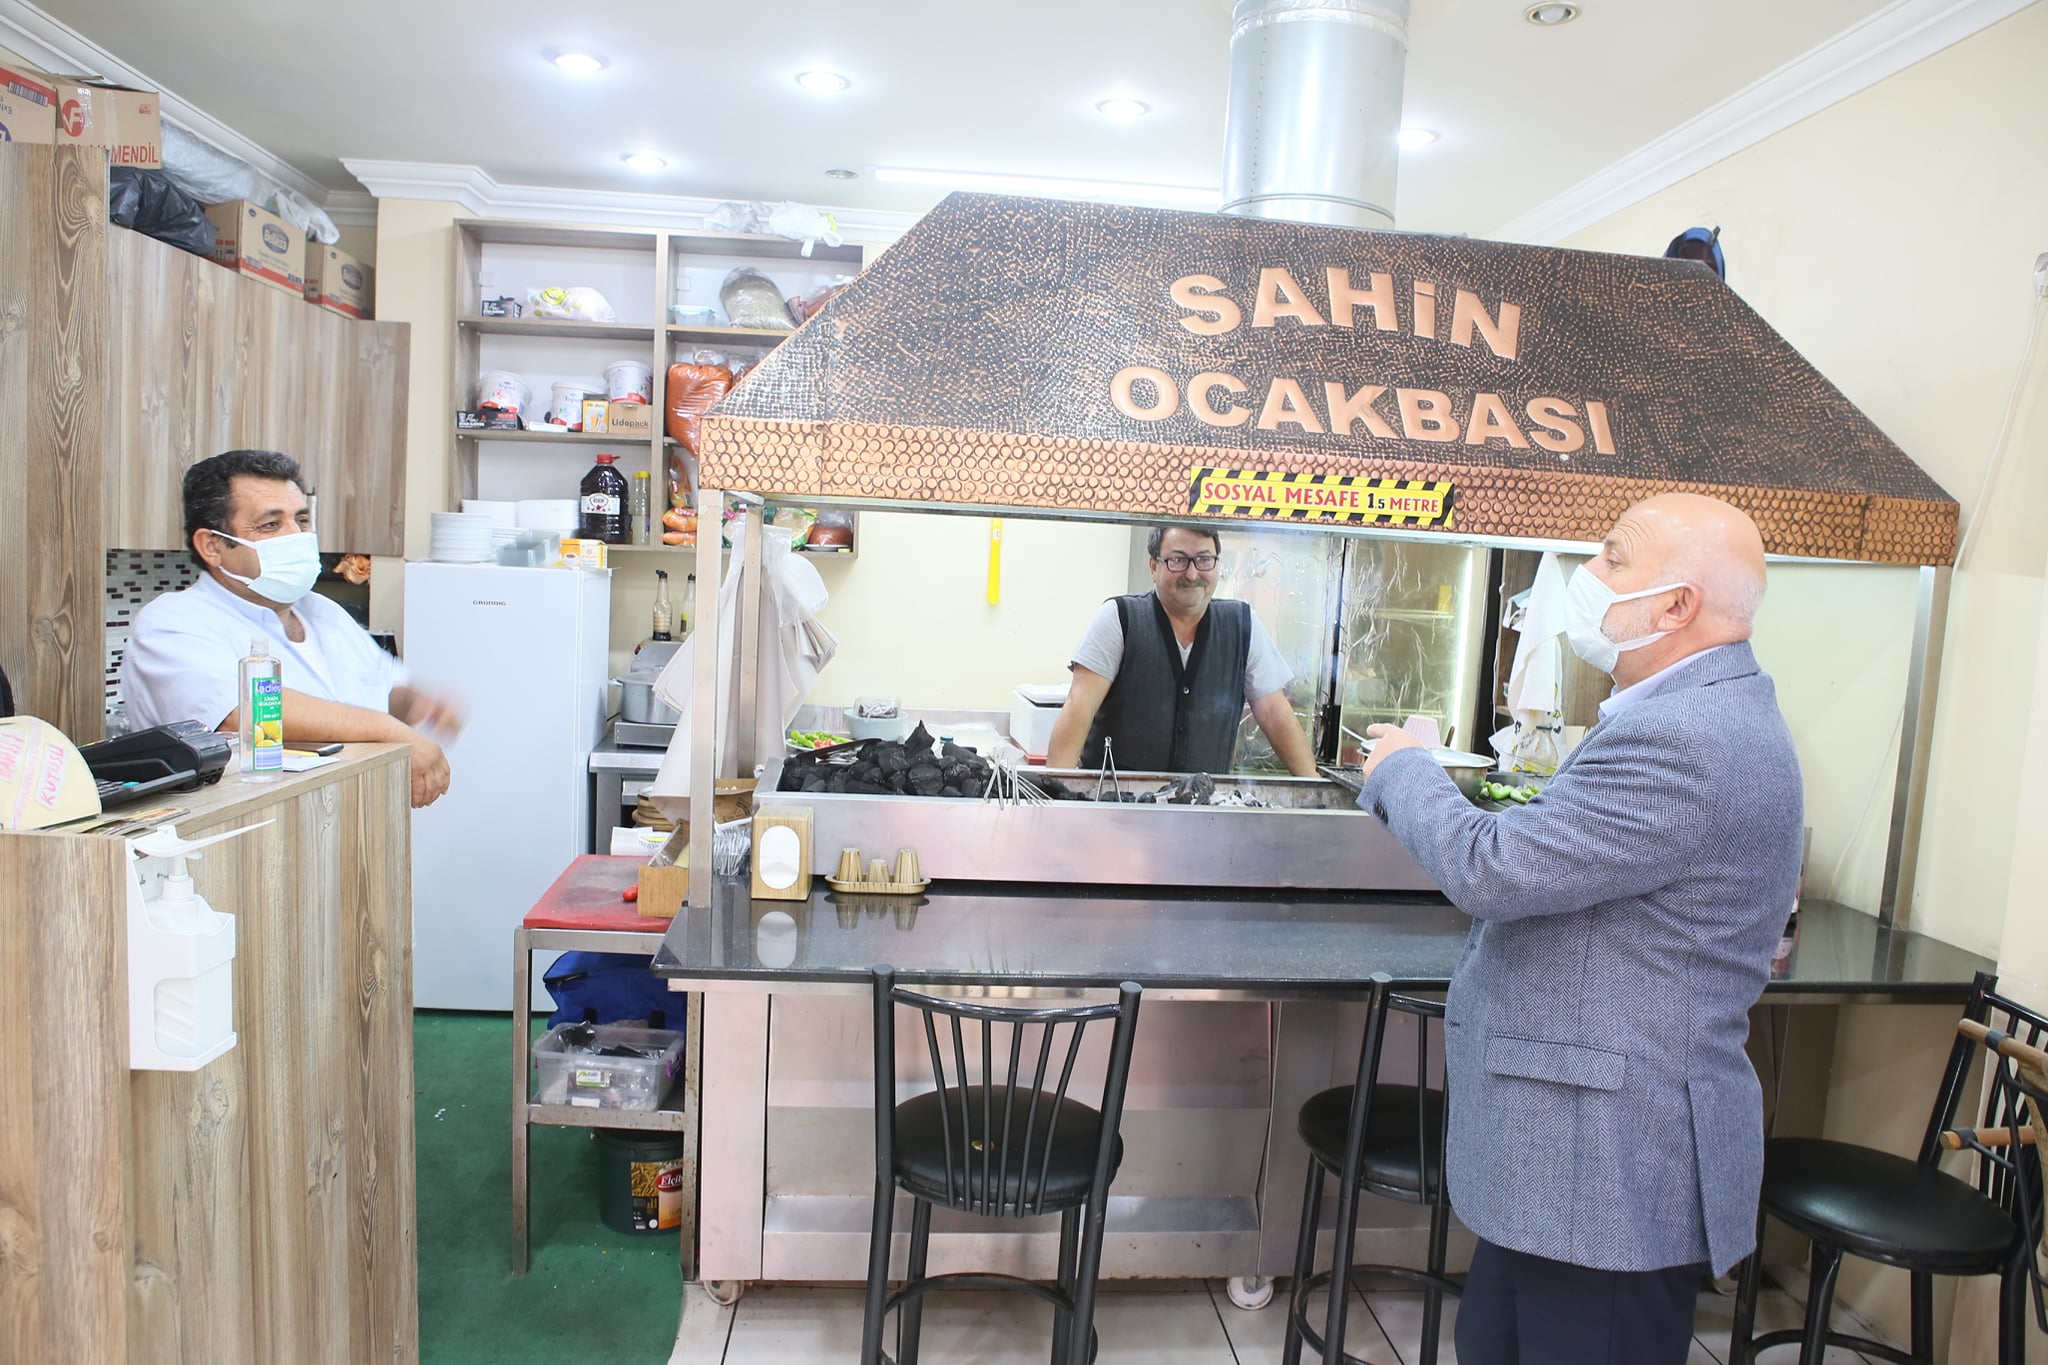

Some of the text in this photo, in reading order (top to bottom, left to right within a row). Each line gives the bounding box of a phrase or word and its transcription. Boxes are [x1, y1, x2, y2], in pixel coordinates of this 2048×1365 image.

[110, 142, 159, 163] MENDİL
[1109, 365, 1616, 455] OCAKBASI
[611, 419, 649, 429] Lidopack
[1203, 482, 1438, 512] SOSYAL MESAFE 1.5 METRE
